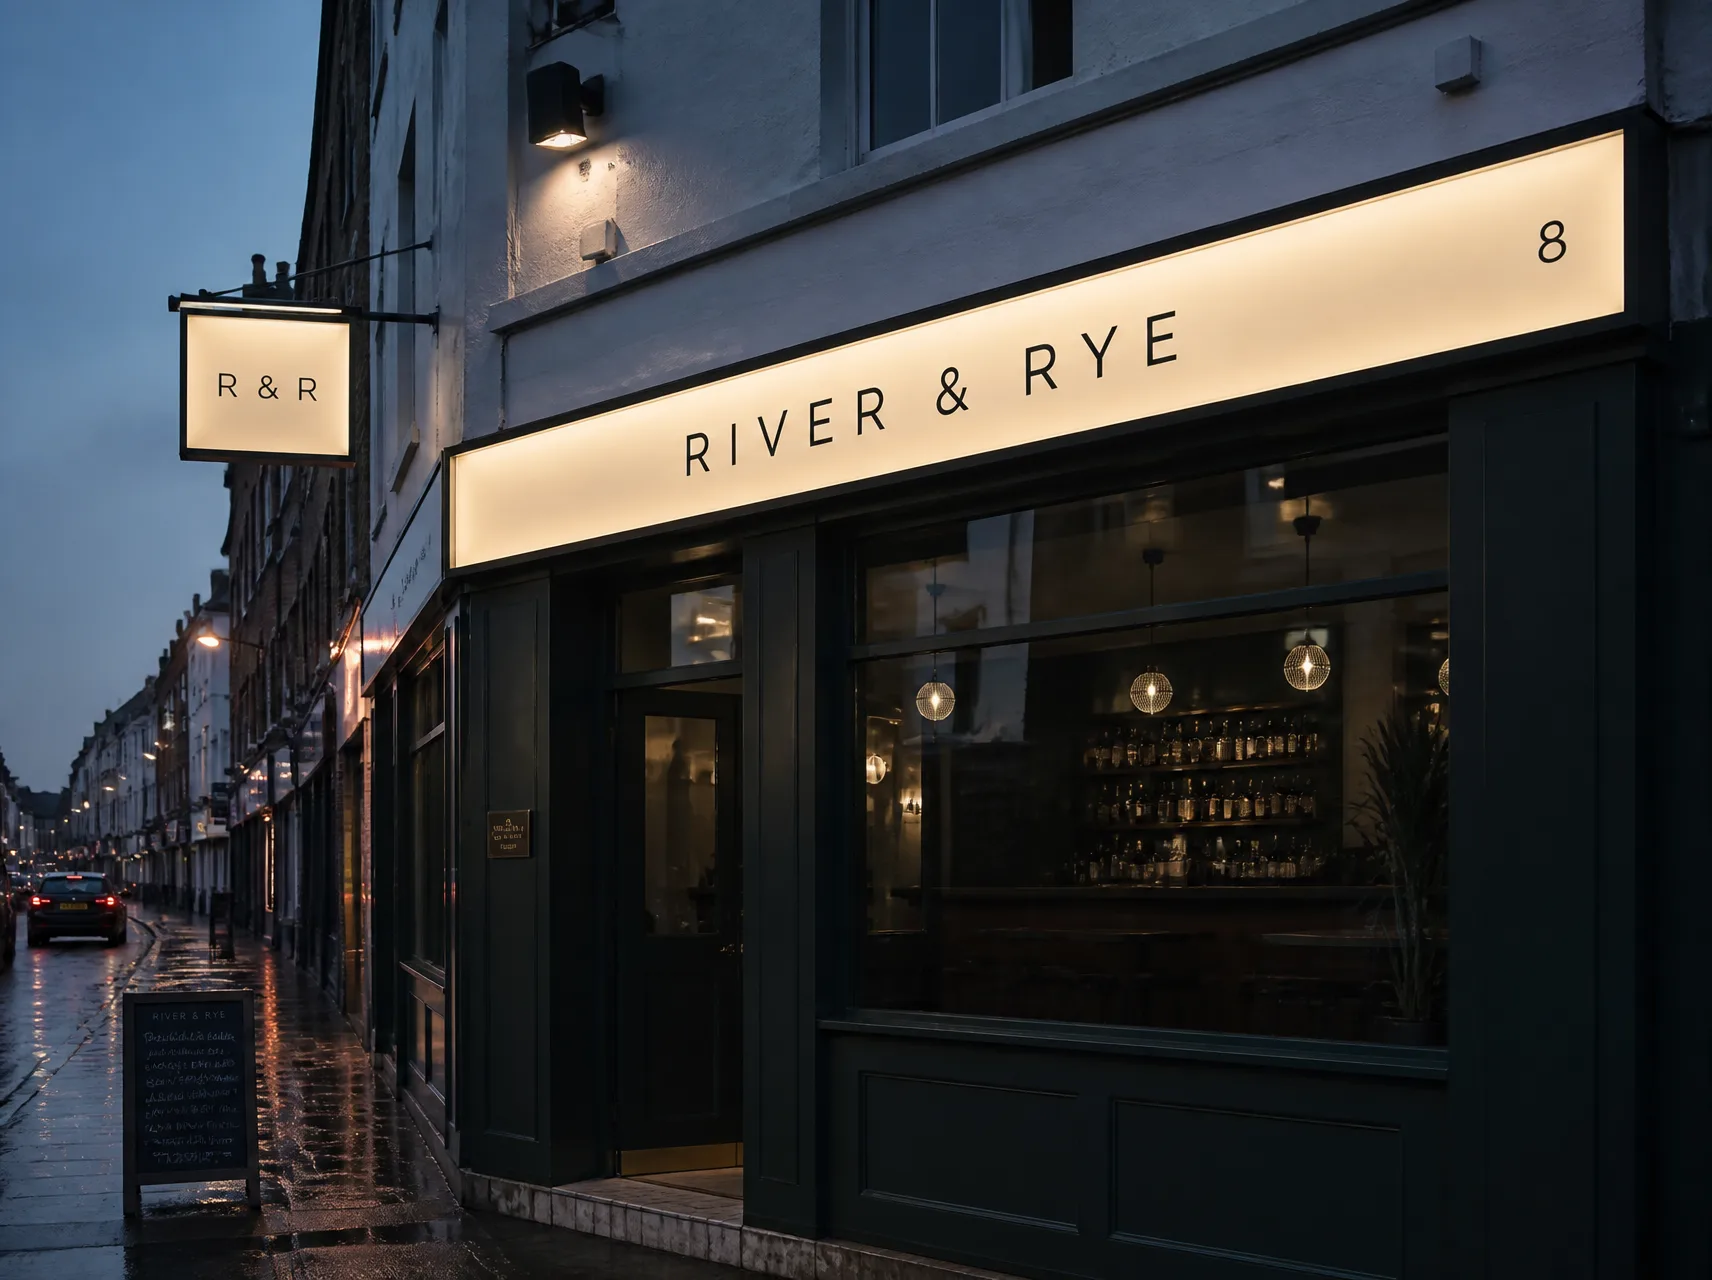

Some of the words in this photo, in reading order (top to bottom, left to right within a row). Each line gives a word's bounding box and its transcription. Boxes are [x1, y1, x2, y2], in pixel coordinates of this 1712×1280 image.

[1538, 220, 1567, 264] 8
[218, 372, 238, 398] R
[257, 374, 279, 400] &
[298, 377, 318, 402] R
[686, 387, 886, 477] RIVER
[936, 366, 969, 416] &
[1025, 310, 1178, 396] RYE
[152, 1012, 187, 1021] RIVER
[192, 1012, 199, 1020] &
[205, 1010, 226, 1020] RYE
